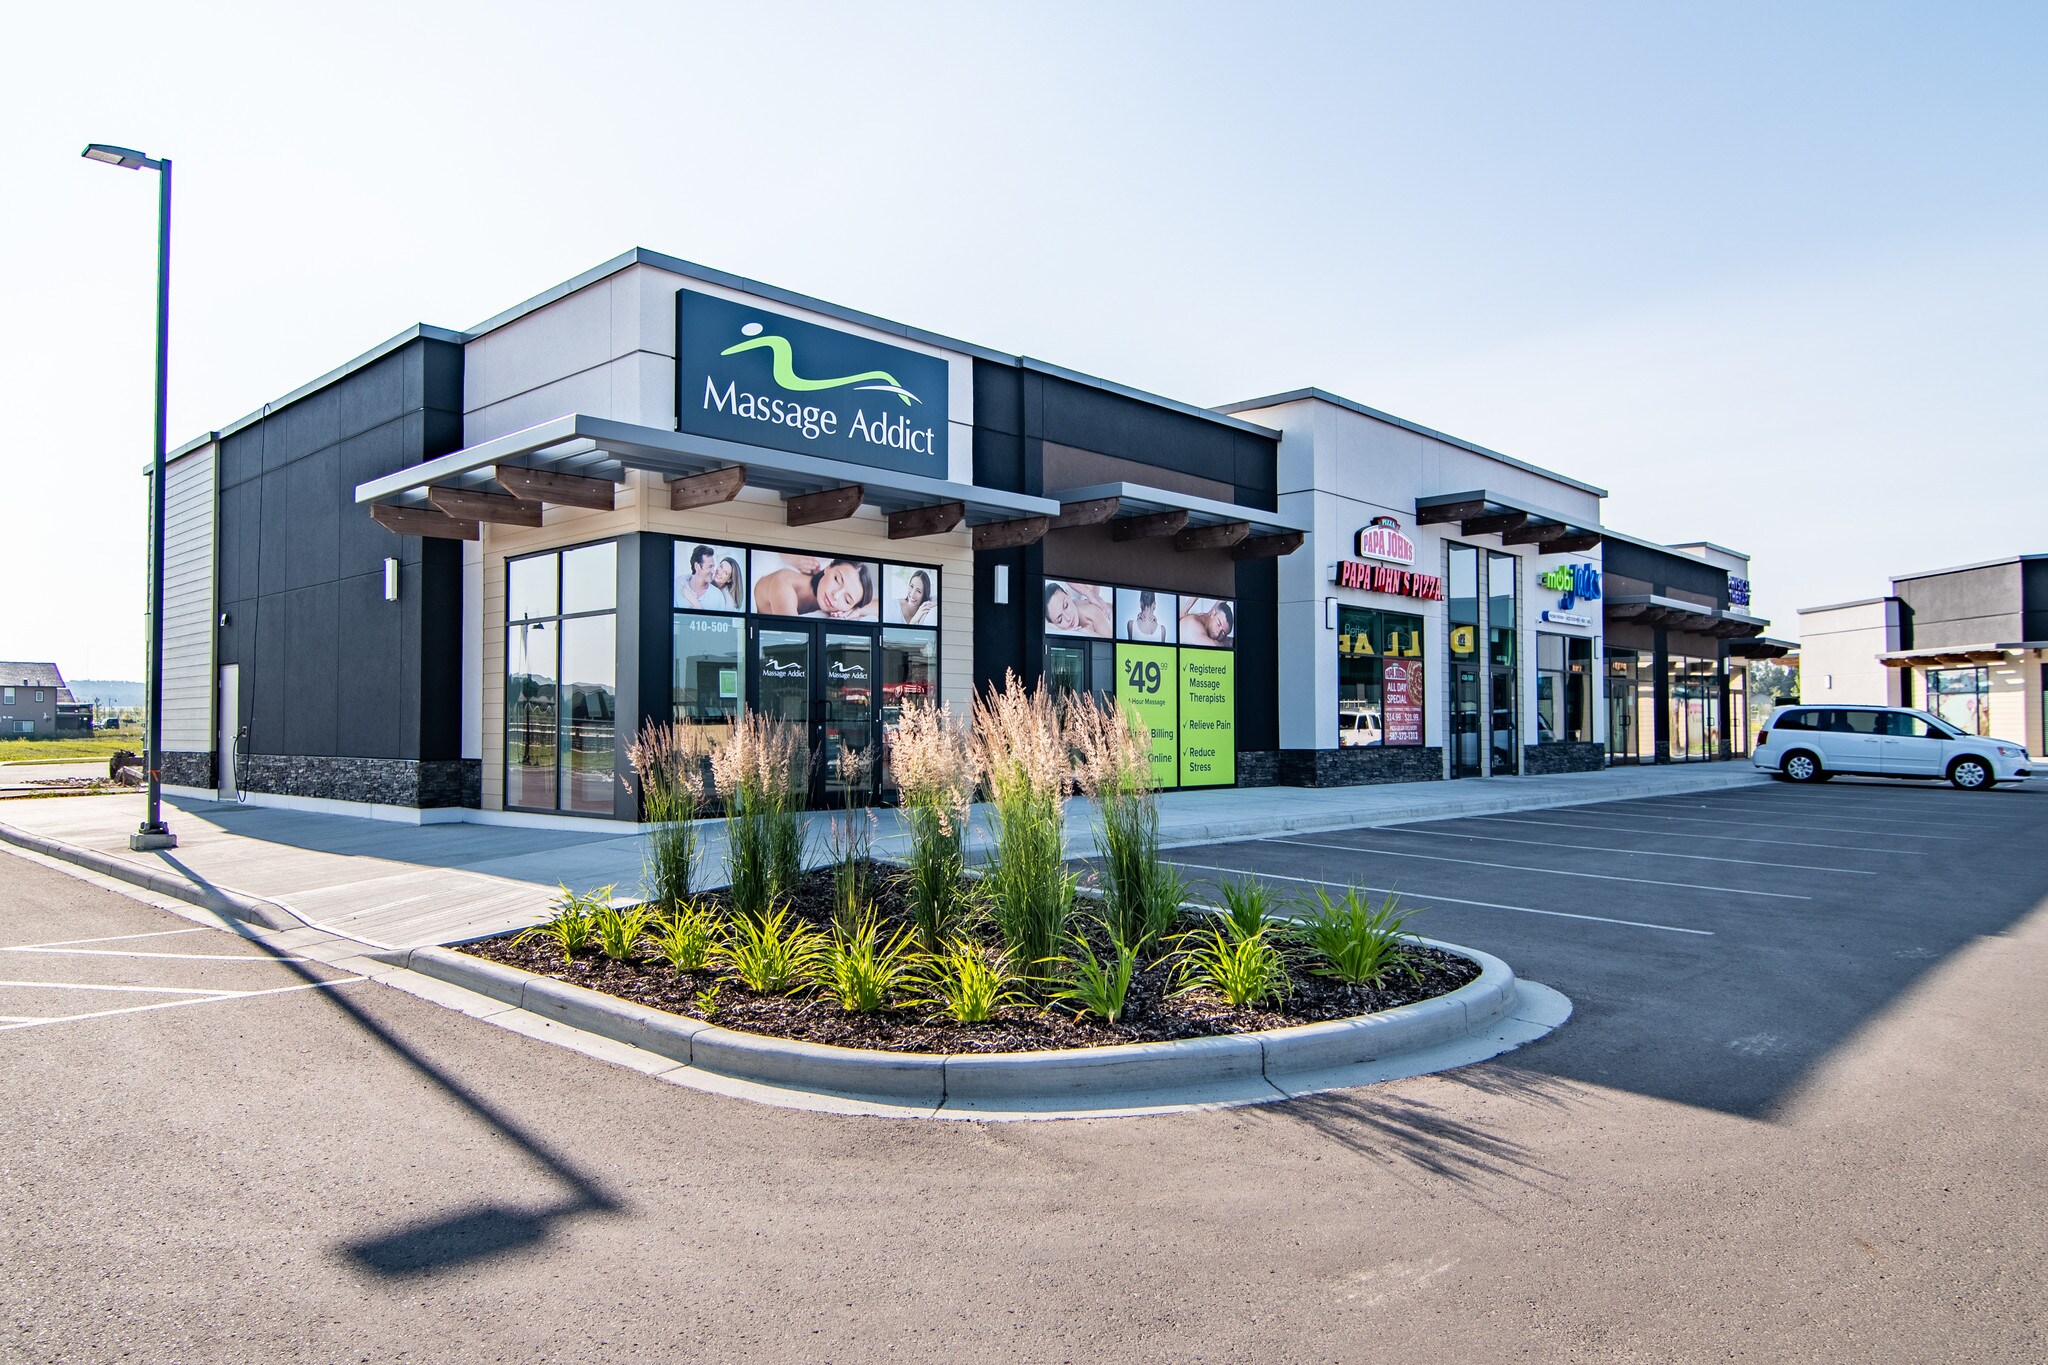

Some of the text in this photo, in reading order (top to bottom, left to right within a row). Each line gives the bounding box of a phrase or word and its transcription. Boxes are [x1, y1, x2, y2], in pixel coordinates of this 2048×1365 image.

[703, 375, 935, 456] Massage Addict
[1363, 530, 1386, 556] PAPA
[1341, 560, 1371, 590] PAPA
[689, 620, 728, 633] 410-500
[762, 669, 806, 678] Massage Addict
[1189, 663, 1227, 676] Registered
[828, 671, 868, 680] Massage Addict
[1189, 677, 1221, 690] Massage
[1387, 683, 1407, 692] ALL DAY
[1145, 697, 1166, 707] Massage
[1189, 692, 1226, 705] Therapists
[1387, 694, 1407, 704] SPECIAL
[1189, 720, 1231, 730] Relieve Pain
[1151, 729, 1174, 741] Billing
[1189, 747, 1216, 757] Reduce
[1148, 753, 1172, 763] Online
[1189, 762, 1211, 772] Stress
